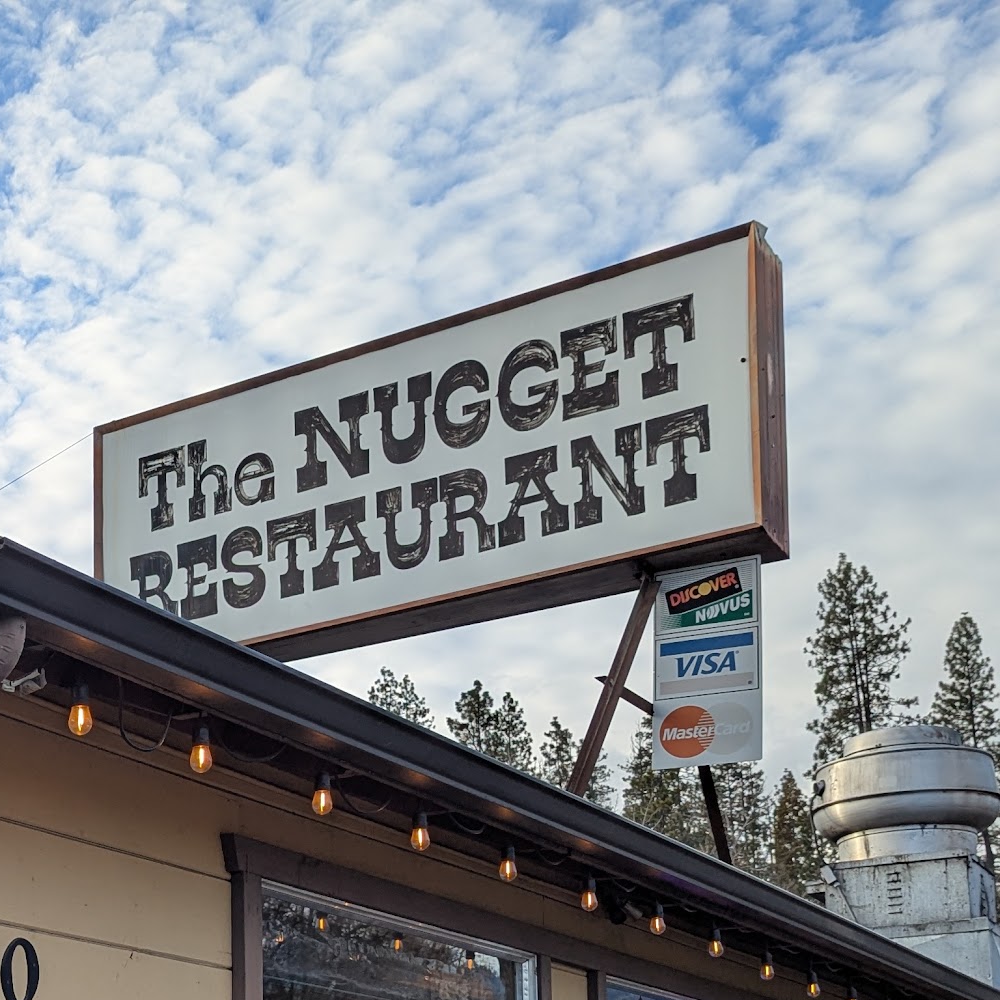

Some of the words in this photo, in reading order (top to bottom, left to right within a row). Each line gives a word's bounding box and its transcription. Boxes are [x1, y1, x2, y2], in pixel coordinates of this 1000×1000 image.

[138, 438, 275, 531] The
[293, 292, 696, 493] NUGGET
[129, 403, 710, 620] RESTAURANT
[669, 571, 738, 607] DISCOVER
[695, 592, 751, 624] NOVUS
[675, 650, 737, 678] VISA
[662, 720, 750, 742] MasterCard
